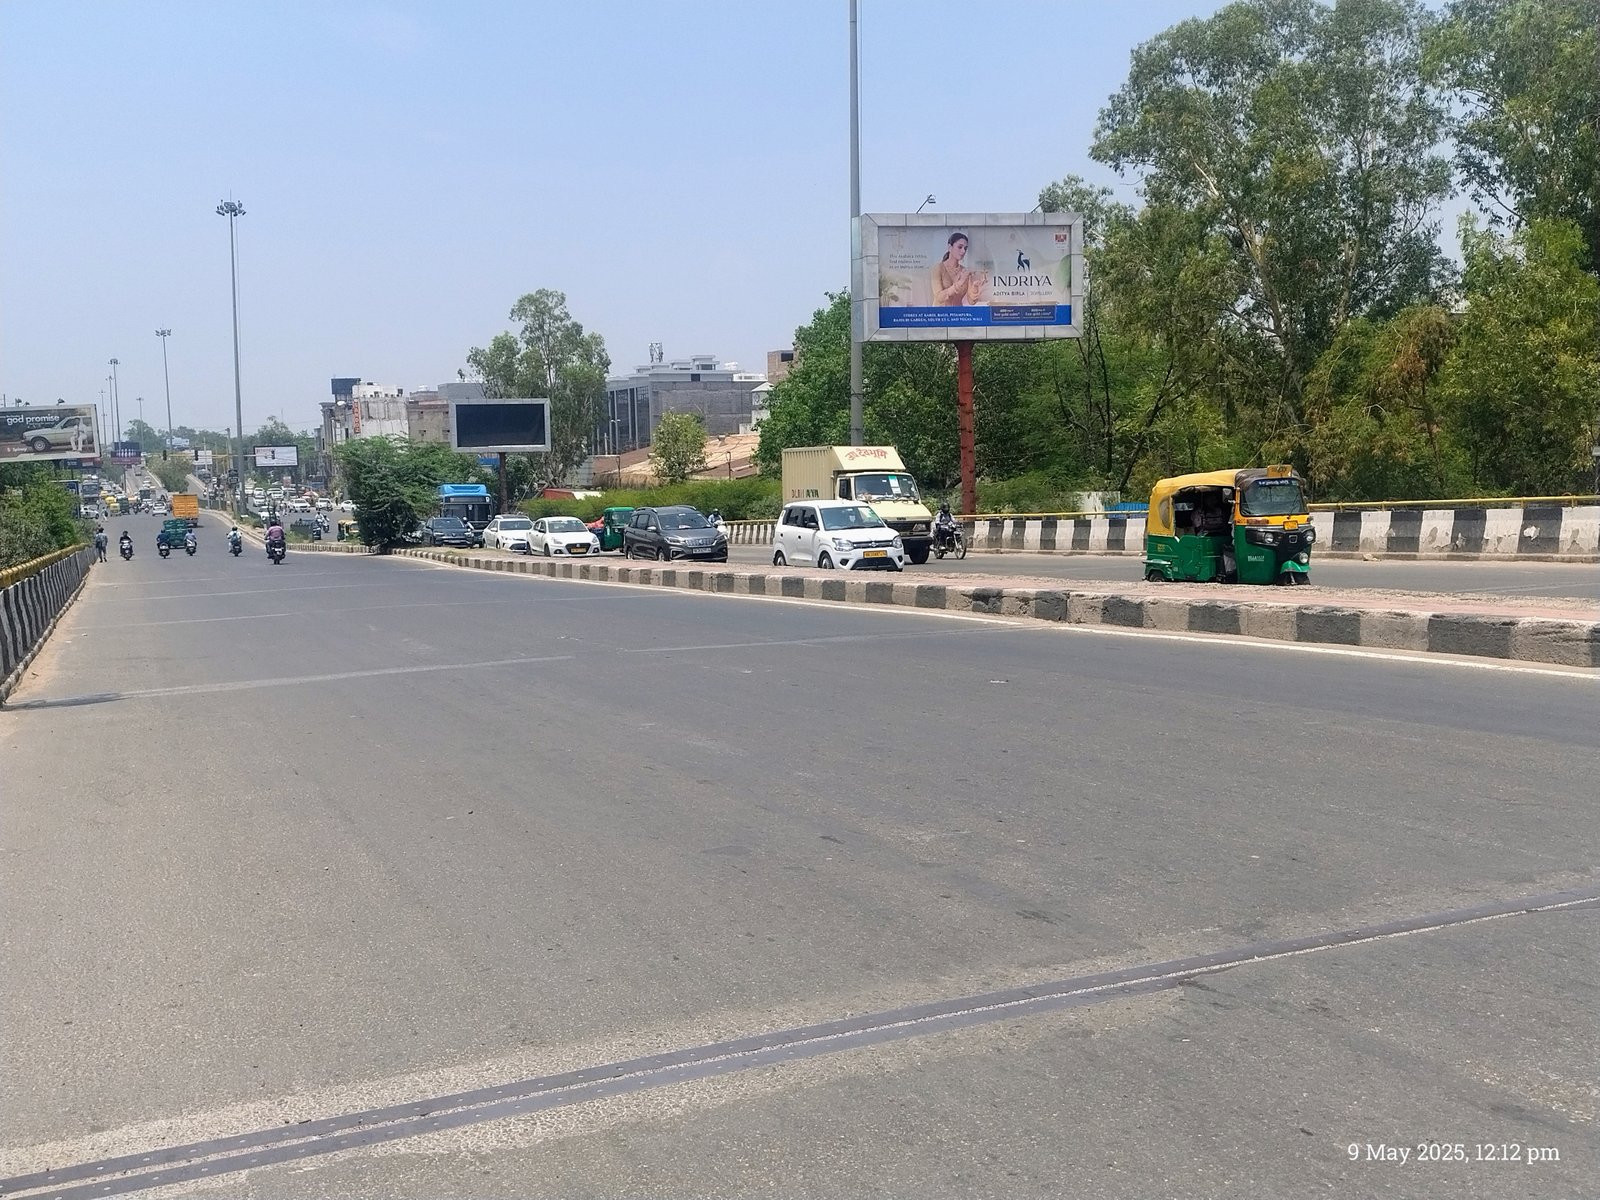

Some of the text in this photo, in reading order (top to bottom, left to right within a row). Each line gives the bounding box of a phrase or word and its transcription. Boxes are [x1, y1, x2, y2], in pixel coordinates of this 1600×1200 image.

[993, 275, 1053, 287] INDRIYA
[7, 414, 60, 426] god promise
